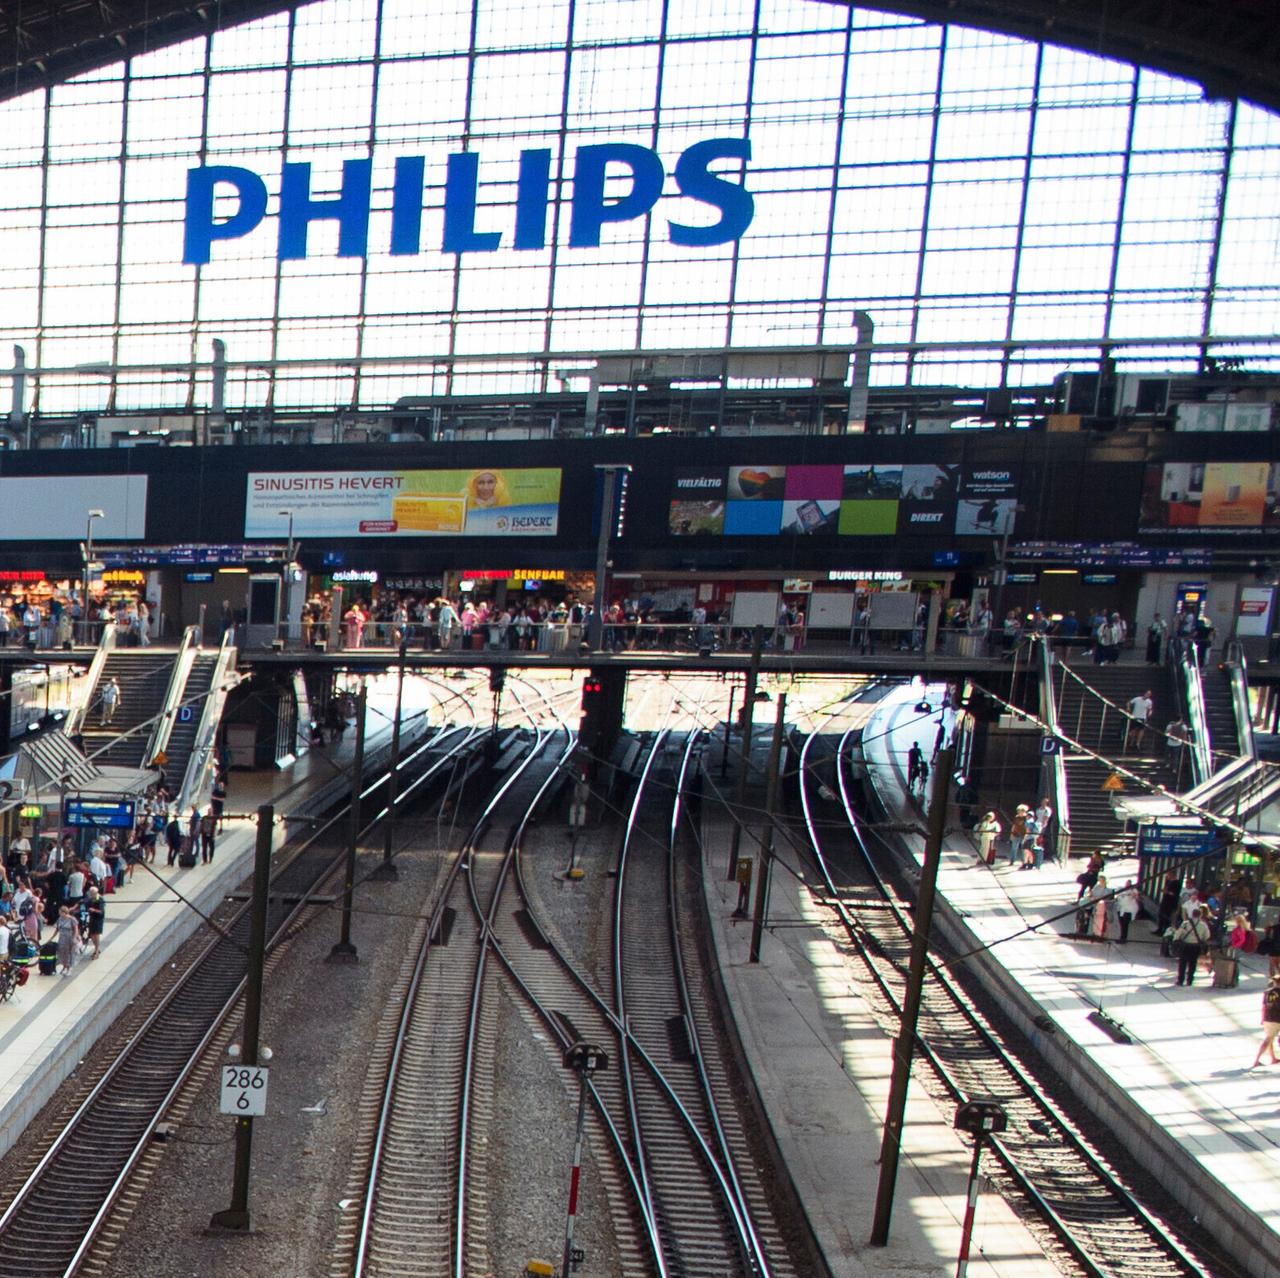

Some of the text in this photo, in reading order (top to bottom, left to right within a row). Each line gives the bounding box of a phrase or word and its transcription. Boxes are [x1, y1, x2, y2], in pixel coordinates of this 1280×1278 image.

[182, 137, 755, 265] PHILIPS
[973, 470, 1009, 479] watson
[254, 476, 404, 491] SINUSITIS HEVERT
[678, 477, 721, 487] VIELFÄLTIG
[911, 513, 944, 522] DIREKT
[514, 569, 565, 580] SENFBAR
[829, 571, 903, 581] BURGER KING
[181, 707, 191, 721] D
[1043, 738, 1056, 752] D
[226, 1068, 264, 1089] 286
[237, 1091, 249, 1110] 6
